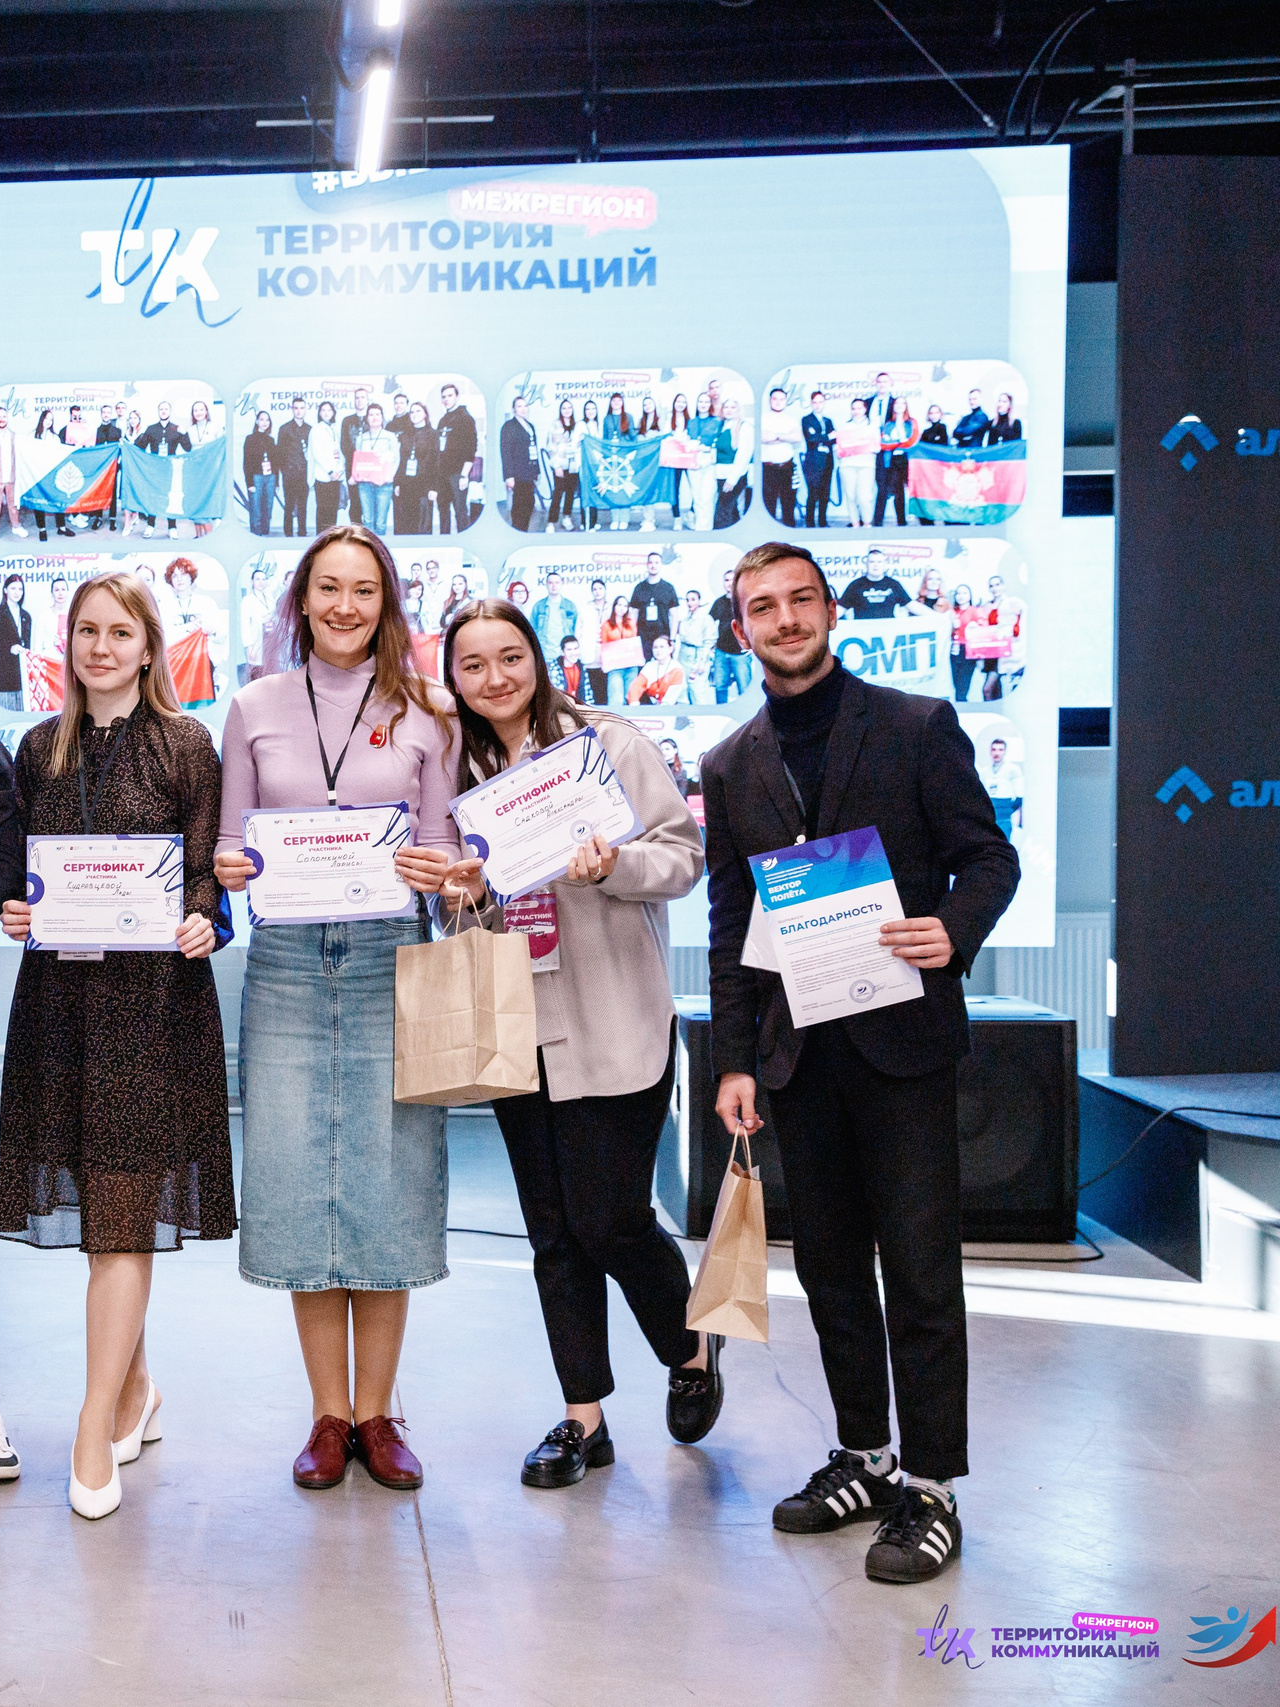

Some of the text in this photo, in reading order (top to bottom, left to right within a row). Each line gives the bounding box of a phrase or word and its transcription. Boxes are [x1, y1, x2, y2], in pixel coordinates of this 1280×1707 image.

[460, 189, 646, 219] МЕЖРЕГИОН
[256, 219, 554, 255] ТЕРРИТОРИЯ
[257, 247, 658, 298] КОММУНИКАЦИЙ
[495, 769, 572, 817] СЕРТИФИКАТ
[283, 832, 371, 846] СЕРТИФИКАТ
[63, 862, 145, 873] СЕРТИФИКАТ
[768, 880, 802, 894] ВЕКТОР
[770, 888, 806, 903] ПОЛЁТА
[780, 903, 883, 935] БЛАГОДАРНОСТЬ
